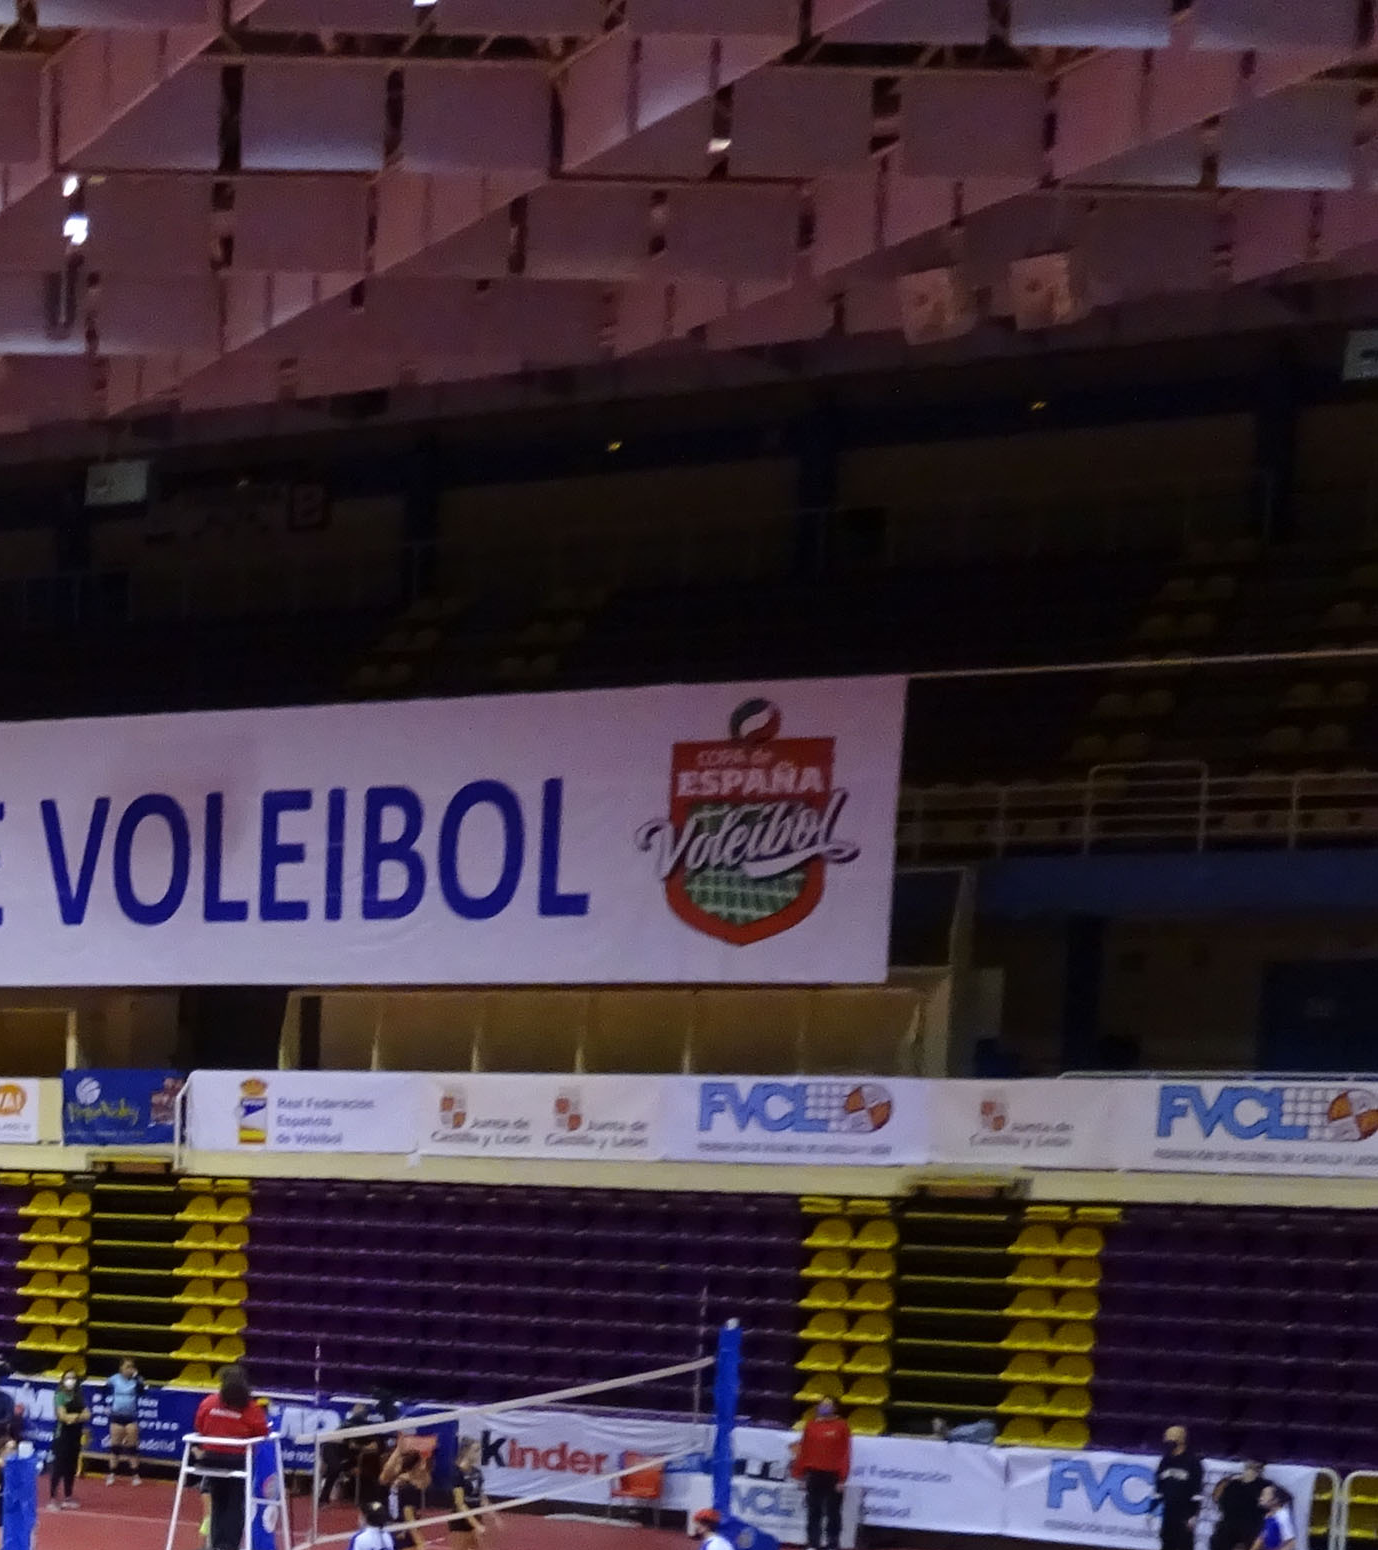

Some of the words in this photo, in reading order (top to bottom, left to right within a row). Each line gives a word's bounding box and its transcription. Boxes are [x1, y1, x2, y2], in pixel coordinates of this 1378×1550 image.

[677, 761, 825, 796] ESPAÑA
[40, 776, 591, 927] VOLEIBOL
[635, 787, 860, 880] Voleibol
[698, 1081, 829, 1133] FVCL
[1156, 1084, 1310, 1141] FVCL
[1046, 1459, 1162, 1518] FVC
